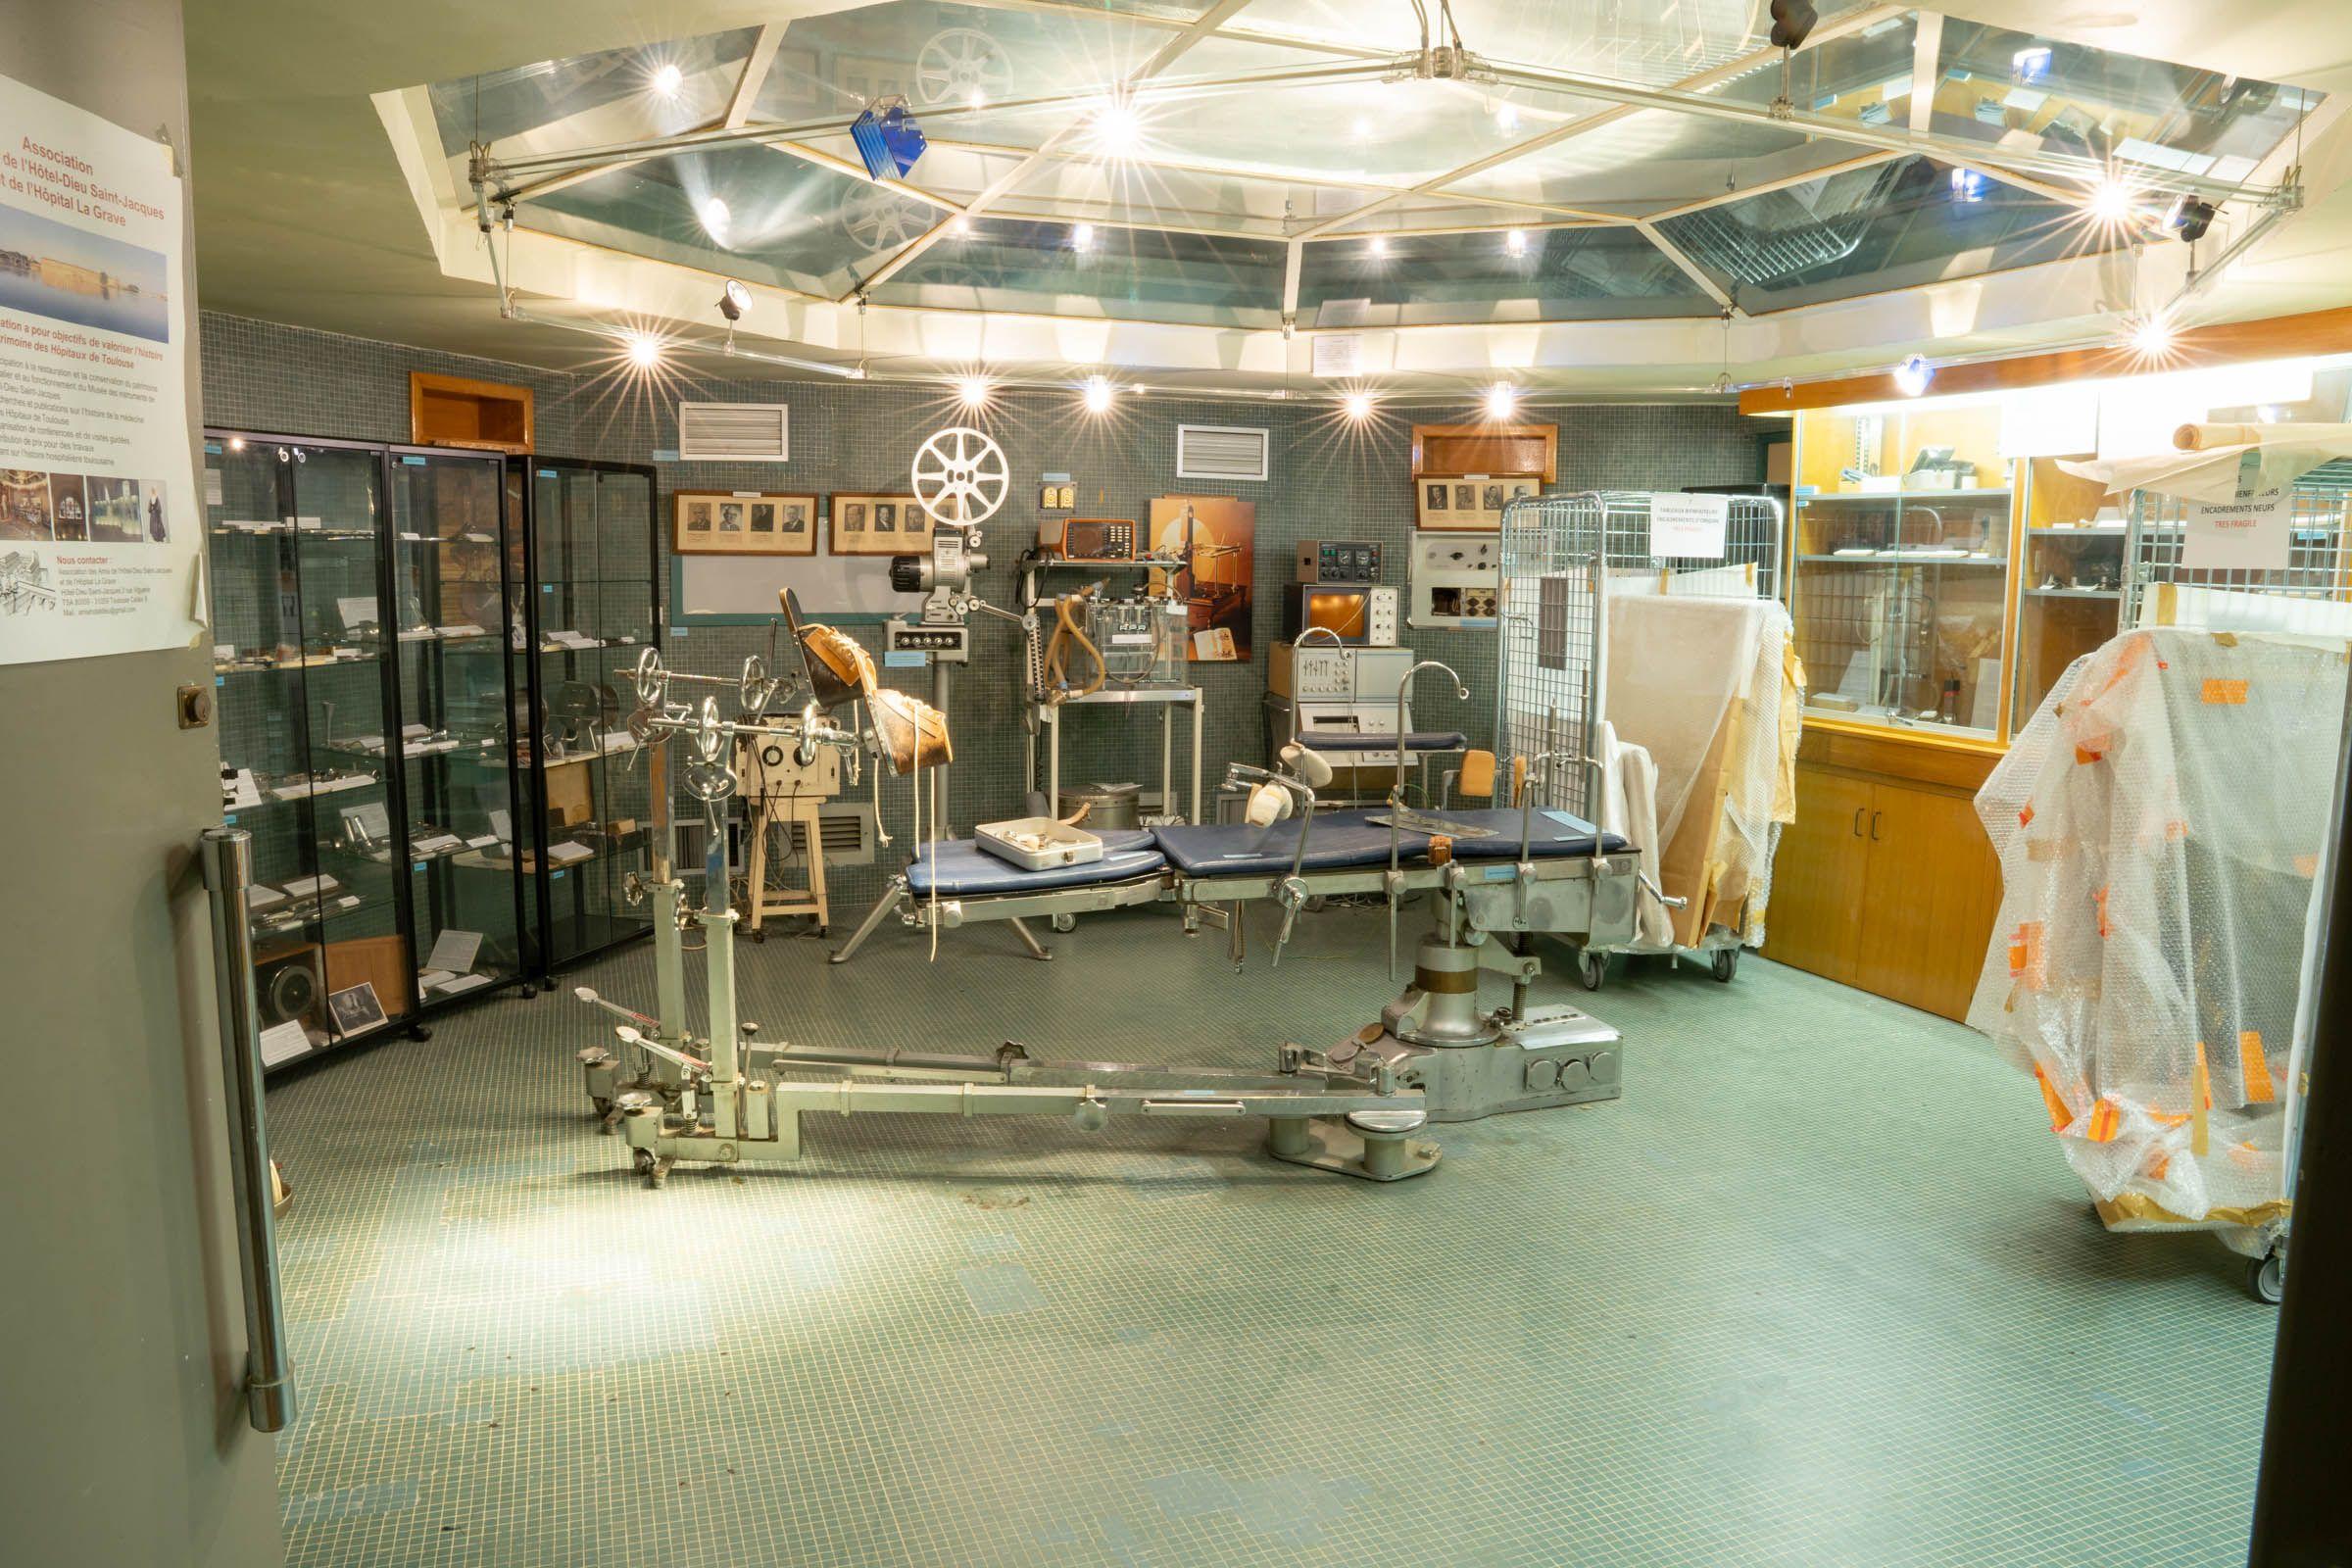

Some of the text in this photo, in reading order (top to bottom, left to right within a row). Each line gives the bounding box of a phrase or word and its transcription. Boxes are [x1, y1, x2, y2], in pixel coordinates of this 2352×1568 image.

[23, 135, 94, 176] Association
[3, 152, 165, 220] de l'Hôtel-Dieu Saint-Jacques
[9, 177, 24, 193] de
[26, 182, 74, 211] l'Hôpital
[77, 199, 90, 216] La
[93, 205, 126, 226] Grave
[0, 334, 134, 368] rimoine des Hôpitaux de Toulouse
[31, 325, 50, 338] pour
[52, 328, 86, 347] objectifs
[89, 336, 100, 348] de
[102, 338, 133, 355] valoriser
[2201, 503, 2275, 514] ENCADREMENTS NEUFS
[2230, 518, 2257, 528] FRAGILE
[56, 556, 75, 564] Nous
[76, 556, 109, 564] contacter
